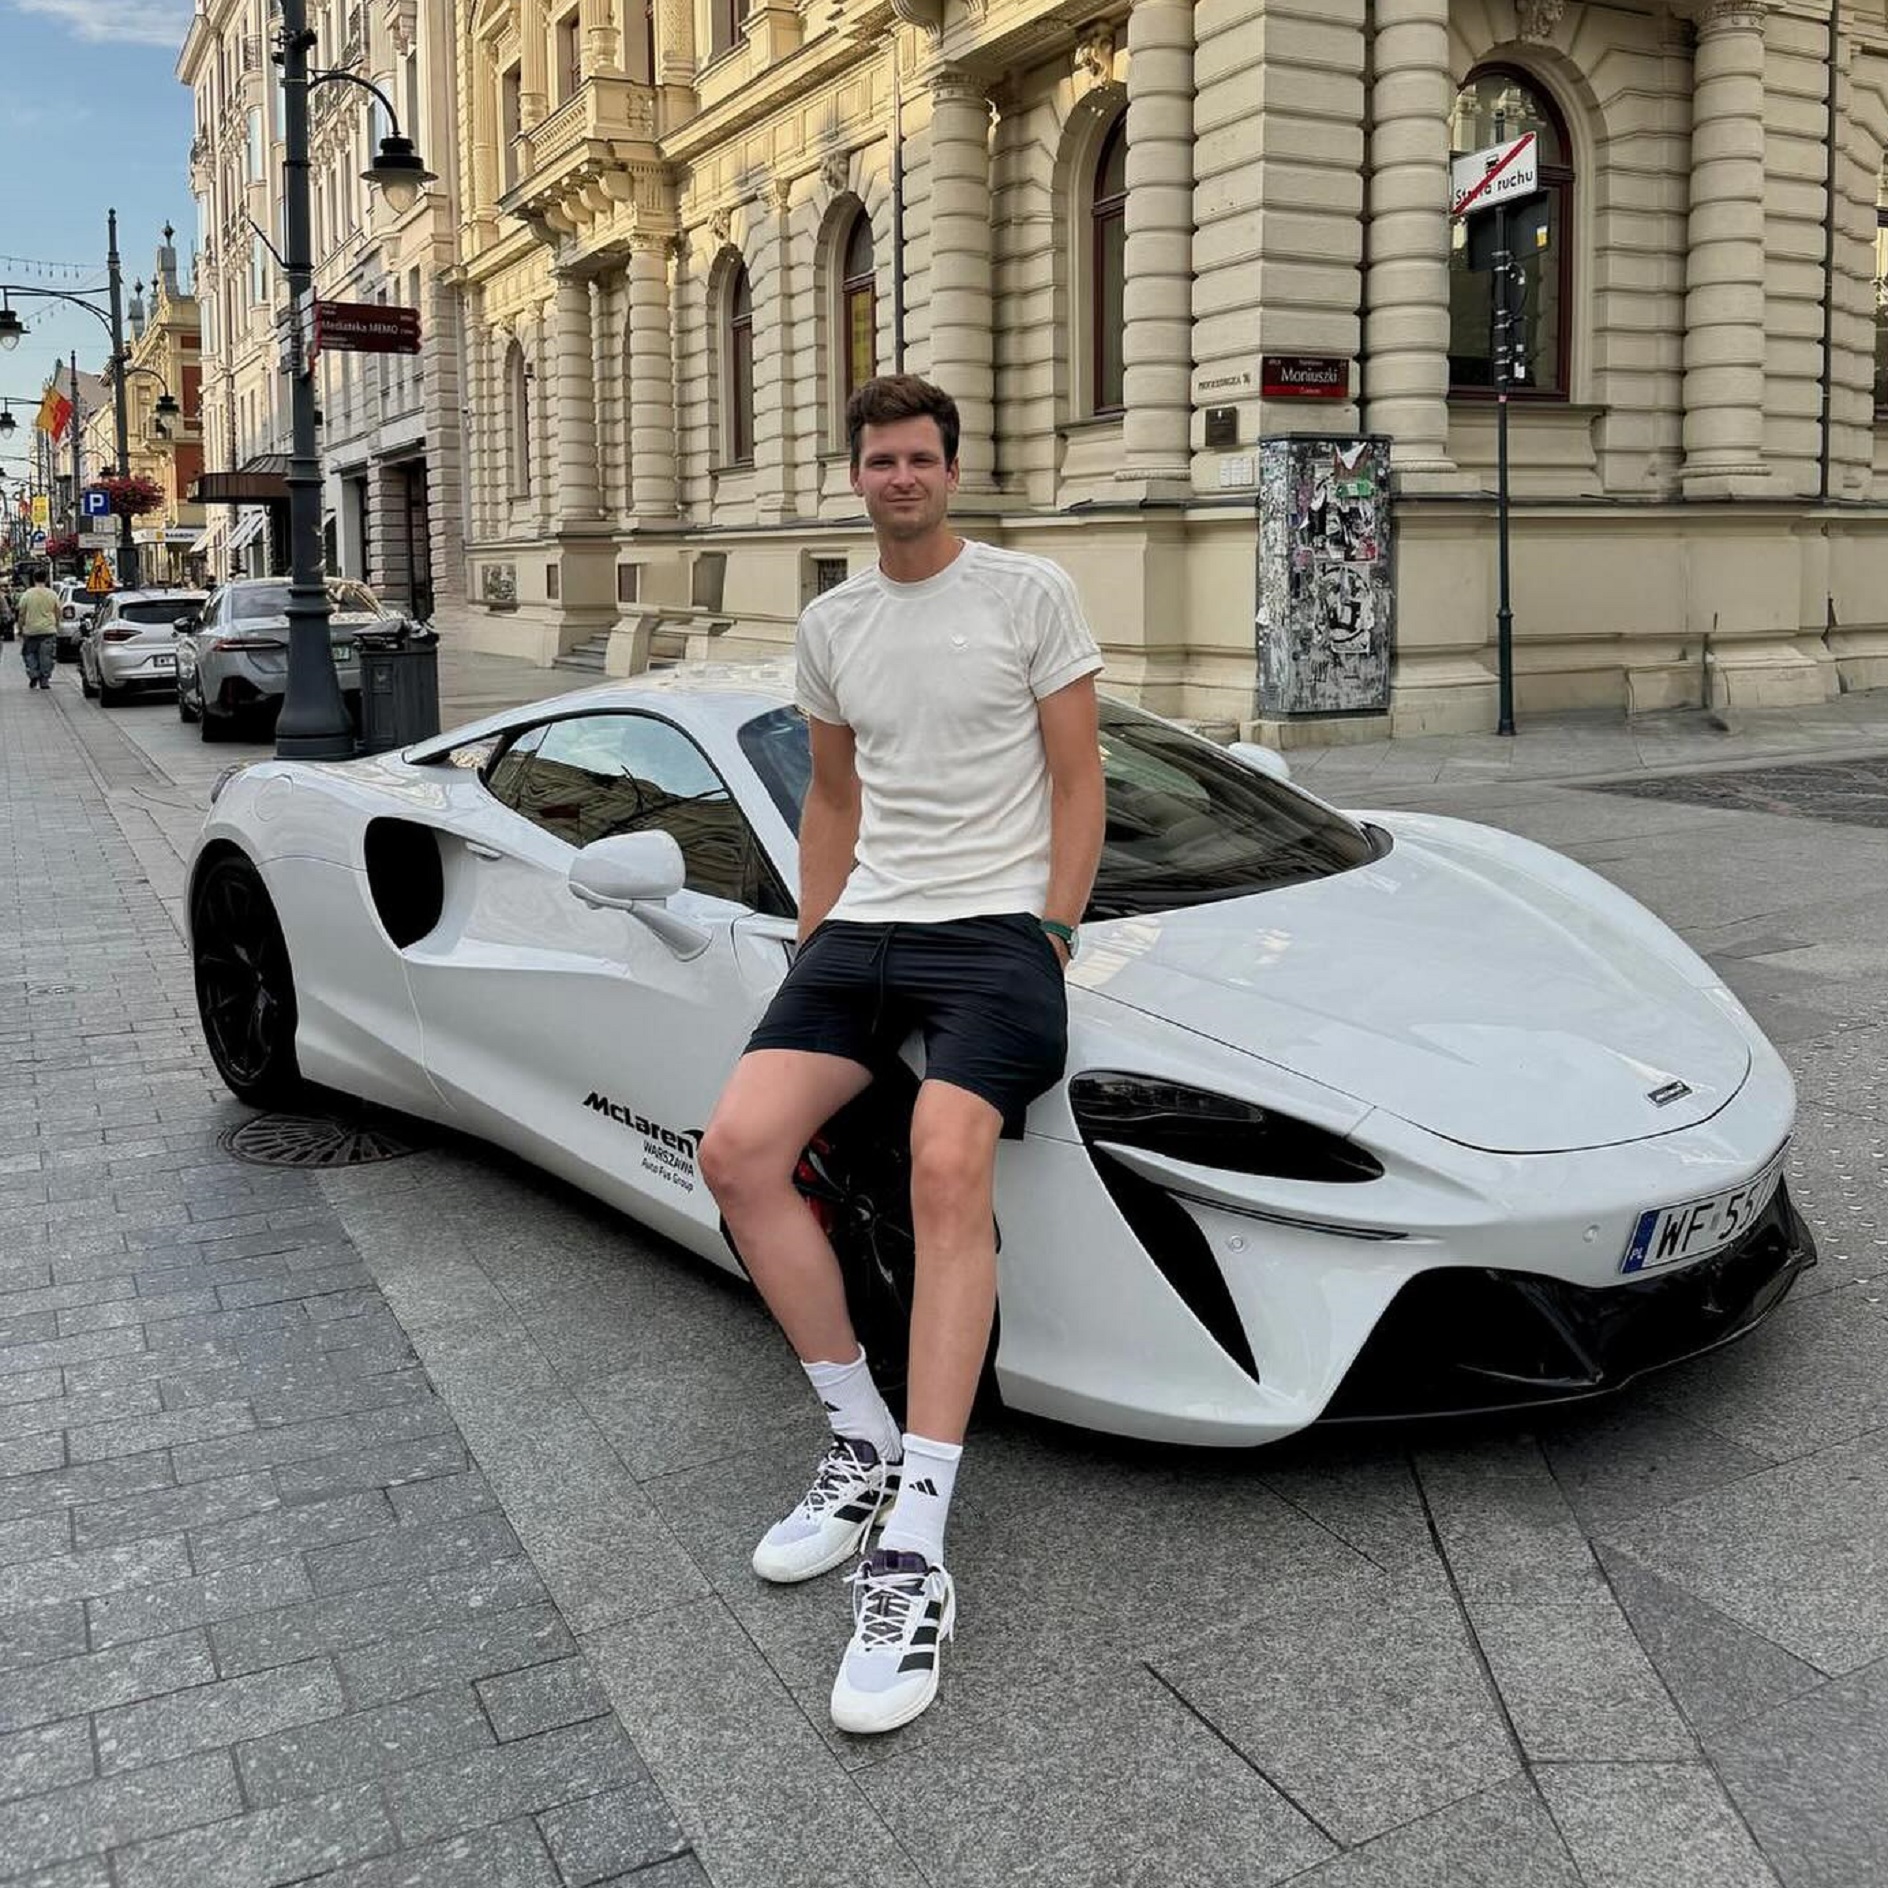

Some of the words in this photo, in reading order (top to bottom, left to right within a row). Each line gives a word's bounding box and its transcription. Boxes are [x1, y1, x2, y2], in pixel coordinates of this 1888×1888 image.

[1497, 170, 1533, 191] ruchu
[1281, 366, 1338, 383] Moniuszki
[89, 493, 105, 513] P
[583, 1092, 694, 1159] McLaren
[641, 1157, 658, 1174] Auto
[659, 1166, 672, 1182] Fus
[673, 1173, 694, 1192] Group
[643, 1139, 694, 1177] WARSZAWA
[1656, 1202, 1715, 1259] WF
